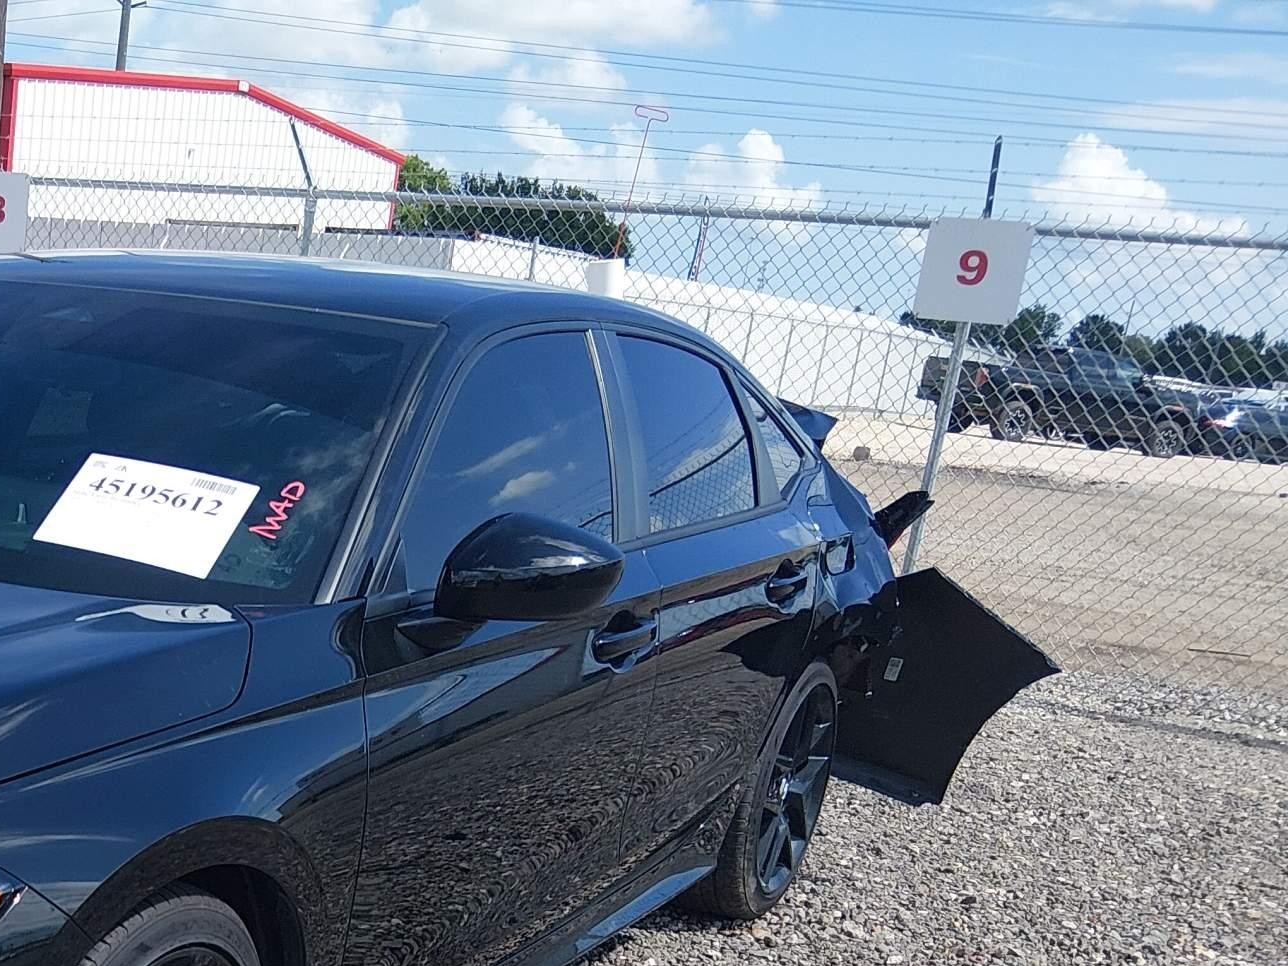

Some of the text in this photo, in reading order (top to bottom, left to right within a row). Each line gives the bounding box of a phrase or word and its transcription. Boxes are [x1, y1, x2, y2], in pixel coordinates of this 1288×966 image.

[956, 249, 989, 286] 9
[88, 476, 223, 517] 45195612
[248, 480, 306, 540] MAD
